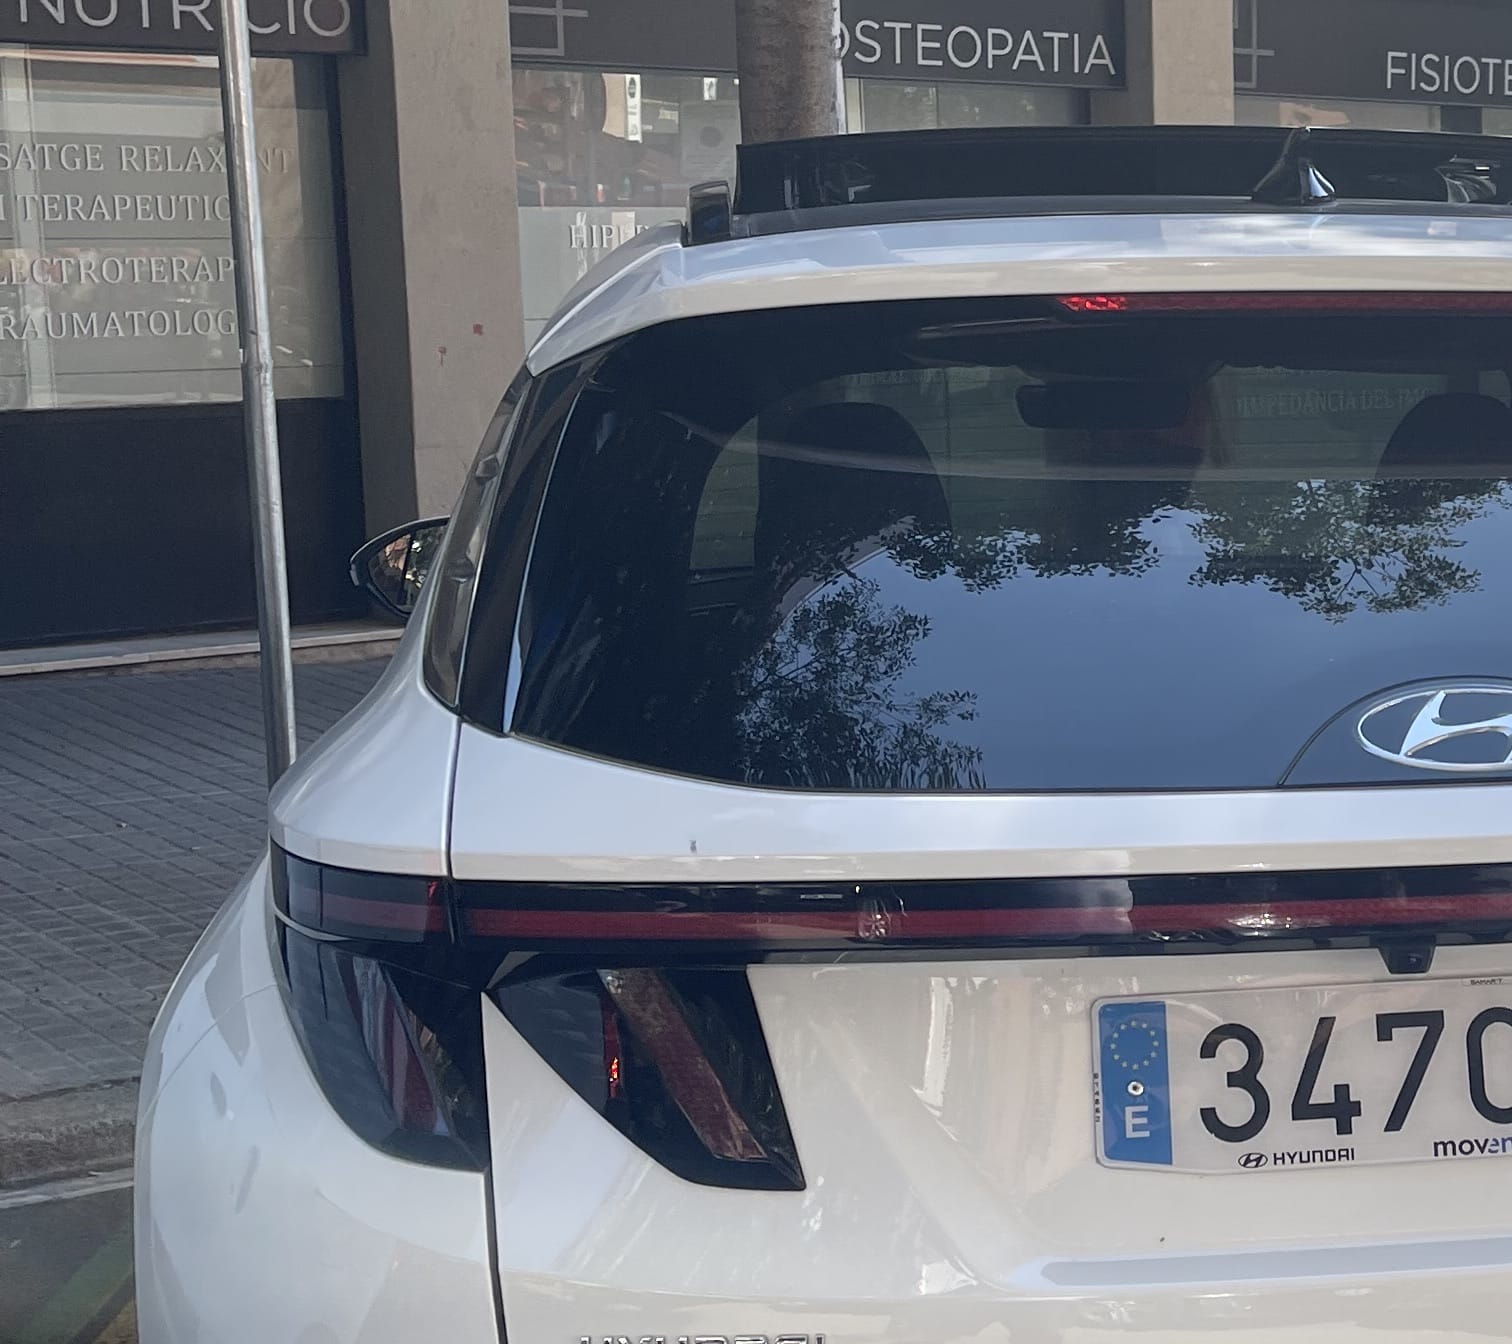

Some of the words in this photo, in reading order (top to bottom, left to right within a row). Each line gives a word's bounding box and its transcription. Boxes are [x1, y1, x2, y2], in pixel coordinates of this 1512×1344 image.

[120, 144, 290, 174] RELAXNT
[1124, 1104, 1151, 1139] E
[1273, 1147, 1355, 1166] HYUNDAI
